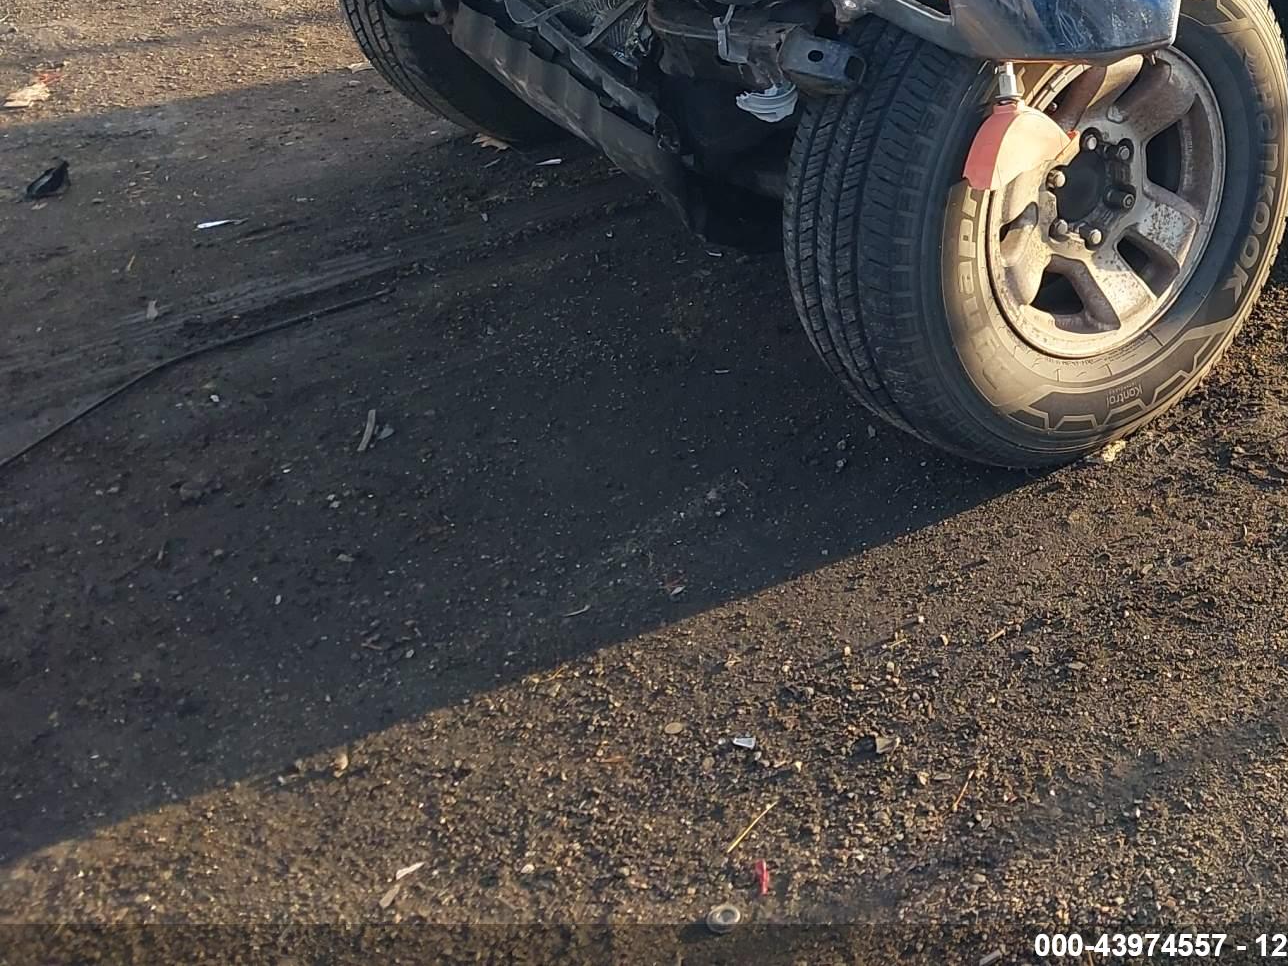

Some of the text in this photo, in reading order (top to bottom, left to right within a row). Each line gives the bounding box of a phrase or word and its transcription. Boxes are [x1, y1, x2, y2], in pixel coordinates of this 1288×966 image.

[957, 185, 1009, 391] Dynapr
[1221, 86, 1280, 304] Hankook
[1106, 383, 1143, 409] Kontrol
